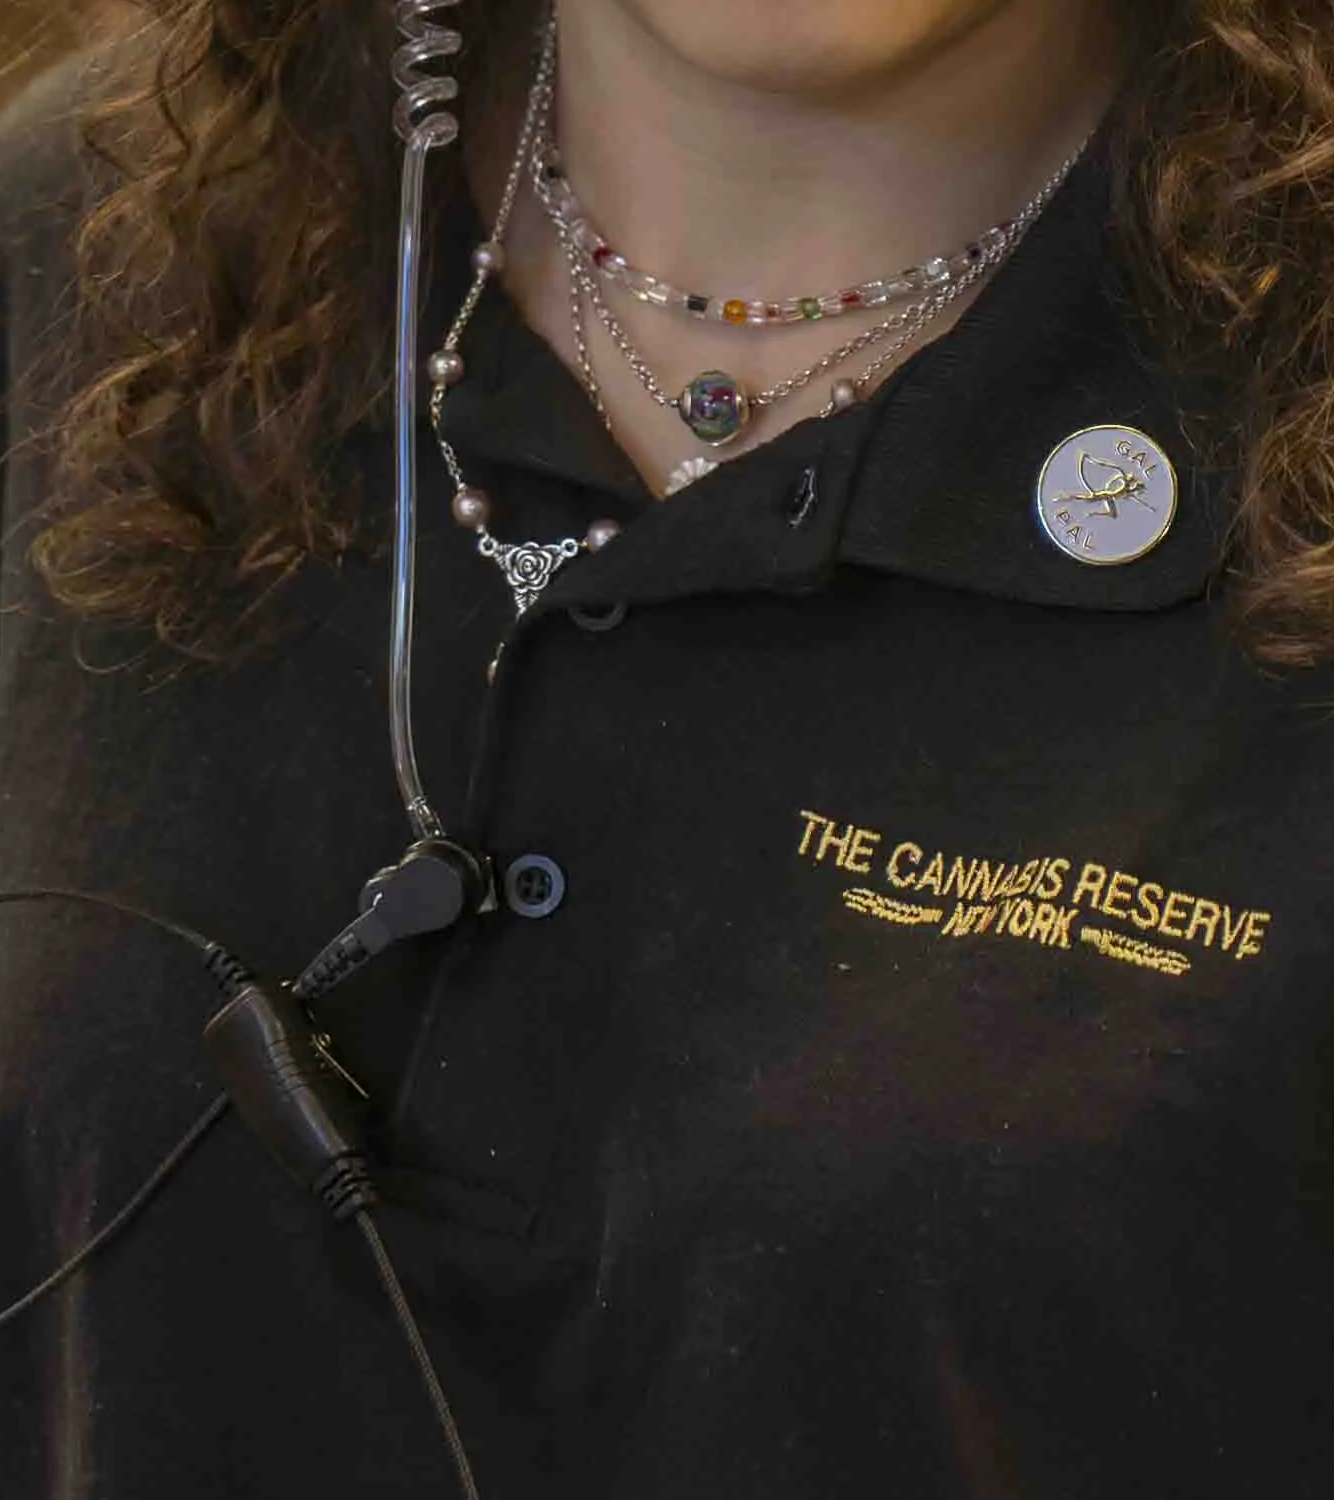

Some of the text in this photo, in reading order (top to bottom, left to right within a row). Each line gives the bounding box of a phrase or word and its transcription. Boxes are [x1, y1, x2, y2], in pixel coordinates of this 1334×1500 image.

[1114, 438, 1158, 481] GAL
[1055, 510, 1097, 551] PAL
[797, 809, 1271, 960] THE CANNABIS RESERVE
[995, 897, 1079, 950] YORK
